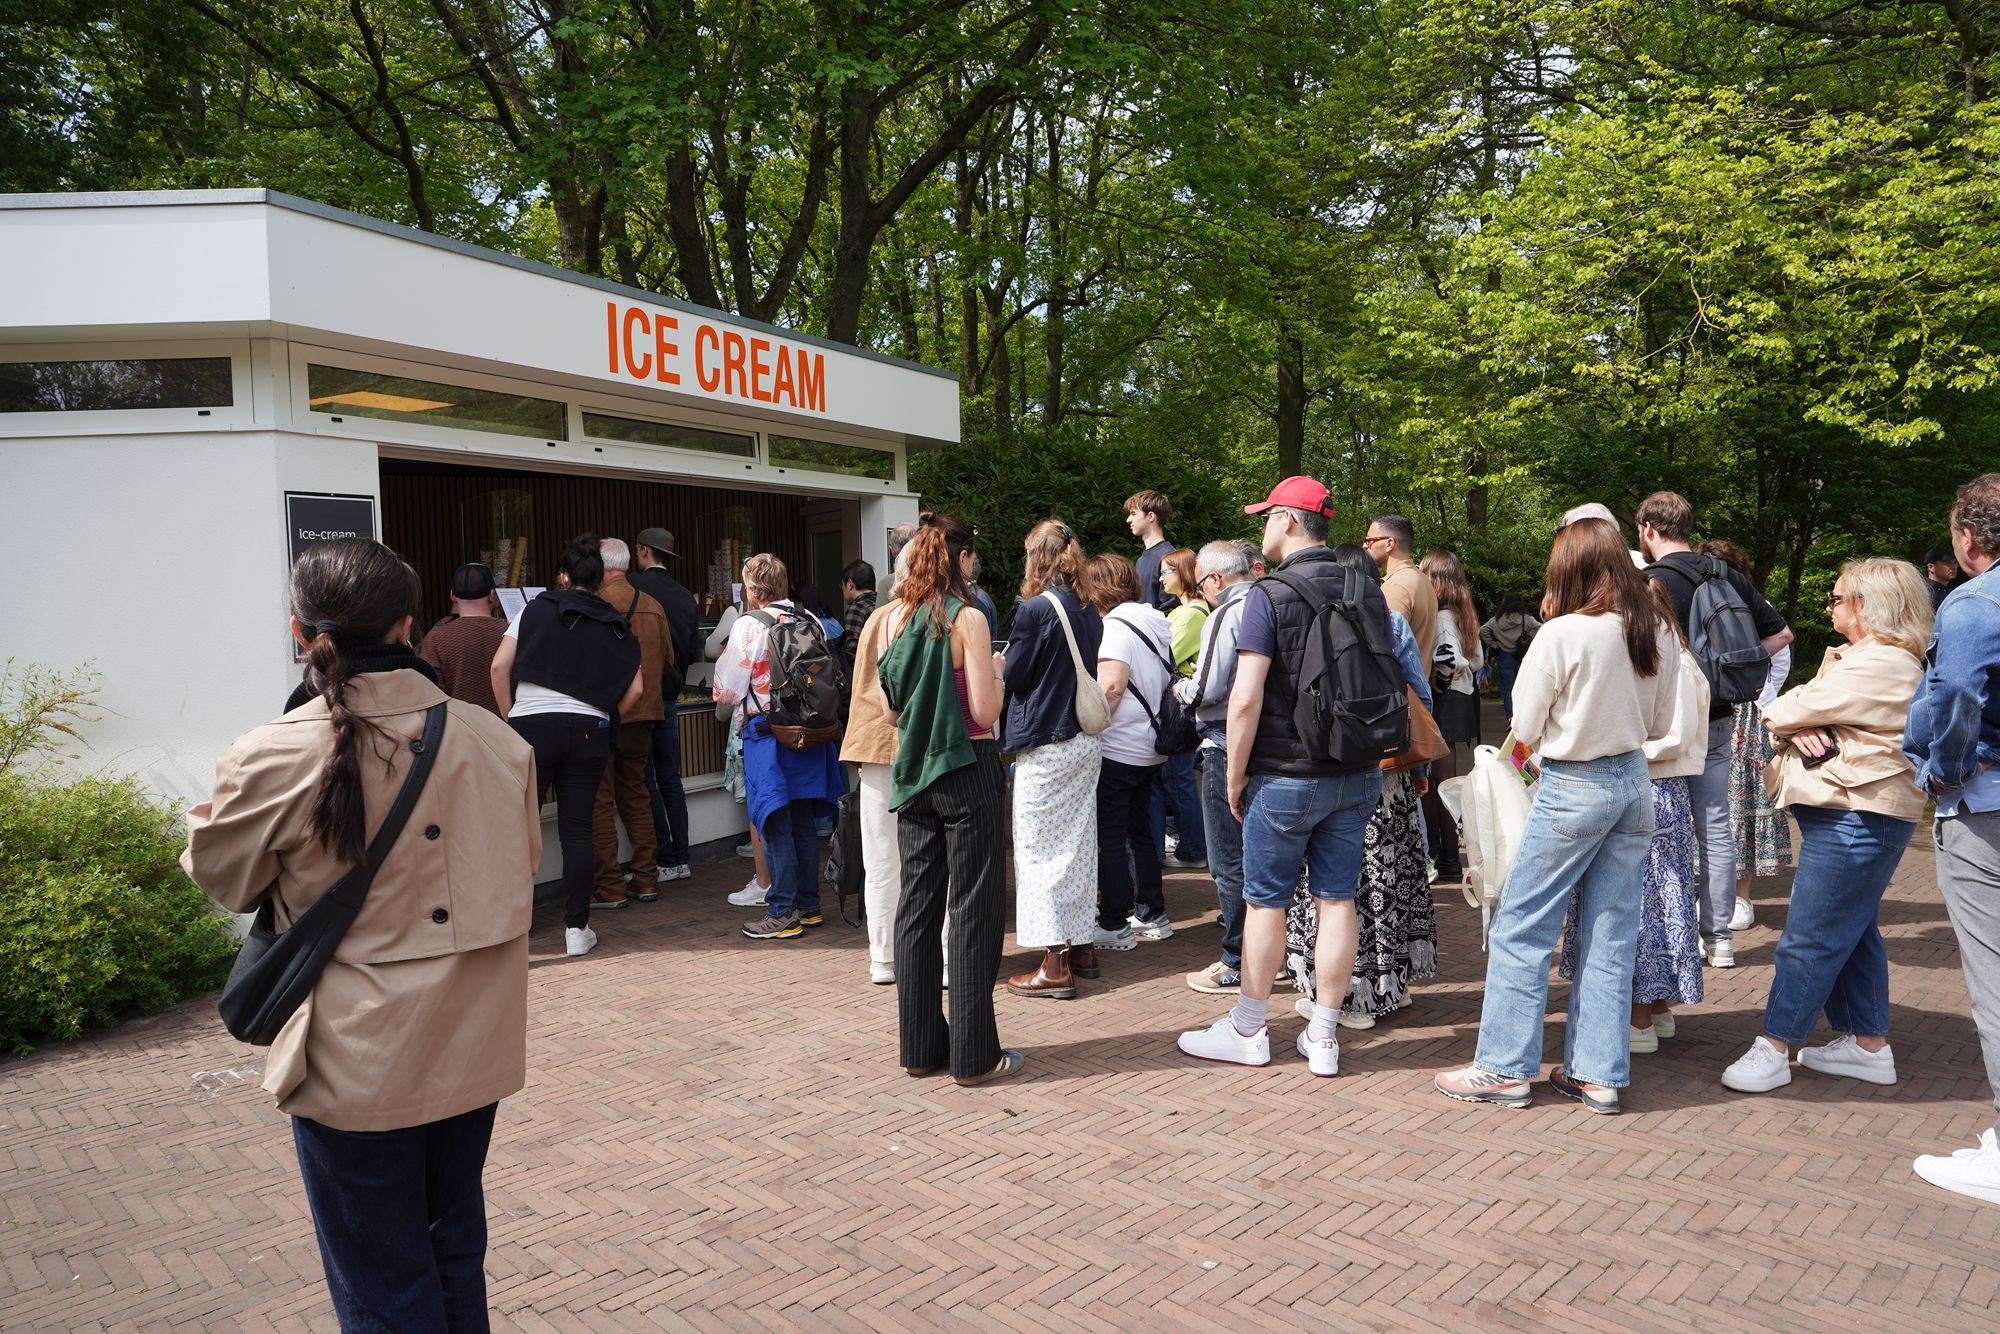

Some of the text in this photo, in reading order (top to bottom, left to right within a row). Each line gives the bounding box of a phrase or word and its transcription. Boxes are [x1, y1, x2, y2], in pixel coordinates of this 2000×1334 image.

[607, 302, 826, 413] ICE CREAM
[299, 528, 356, 540] Ice-cream
